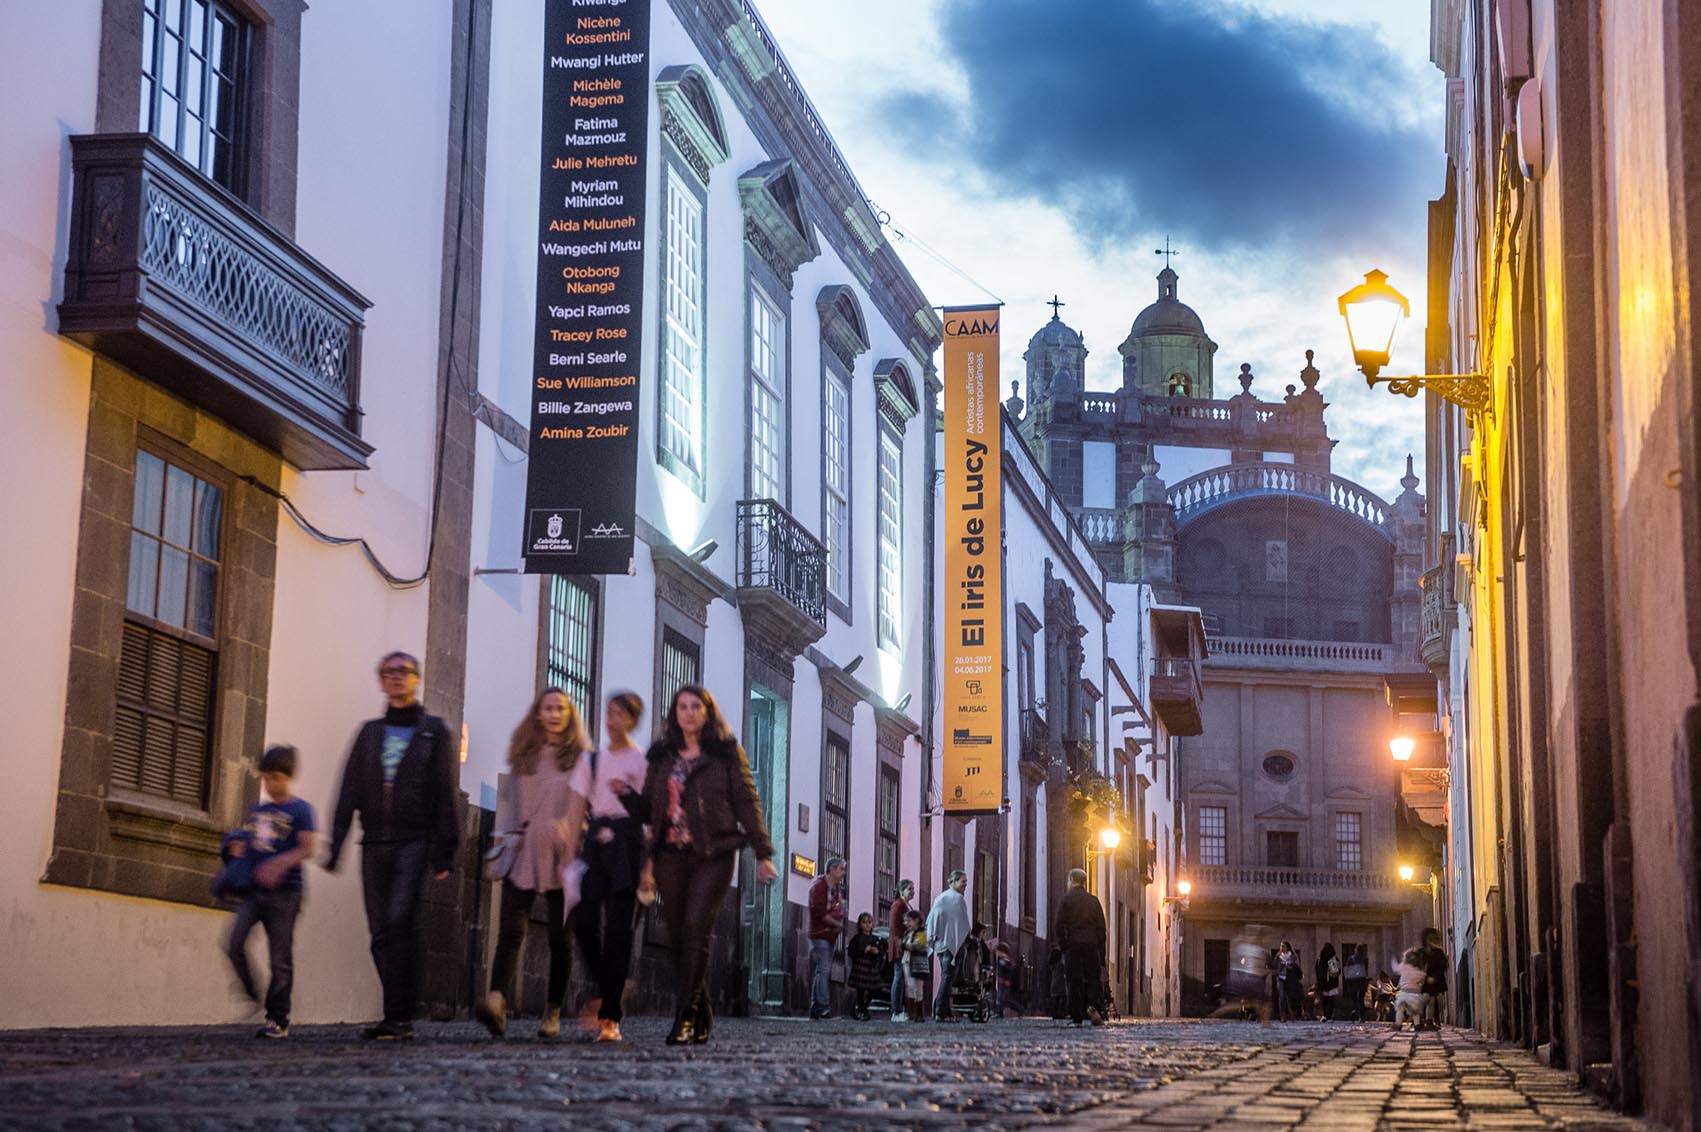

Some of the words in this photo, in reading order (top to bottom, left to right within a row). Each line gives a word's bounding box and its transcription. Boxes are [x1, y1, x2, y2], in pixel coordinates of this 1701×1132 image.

[577, 16, 621, 29] Nicène
[566, 29, 631, 45] Kossentini
[551, 54, 601, 69] Mwangi
[604, 53, 644, 67] Hutter
[573, 78, 622, 92] Michèle
[569, 94, 624, 108] Magema
[575, 117, 618, 131] Fatima
[565, 132, 627, 146] Mazmouz
[551, 157, 583, 170] Julie
[586, 154, 638, 168] Mehretu
[571, 180, 618, 194] Myriam
[564, 194, 624, 208] Mihindou
[548, 219, 580, 232] Aida
[583, 215, 636, 230] Muluneh
[541, 241, 607, 257] Wangechi
[610, 239, 641, 253] Mutu
[562, 266, 620, 279] Otobong
[566, 281, 615, 294] Nkanga
[548, 304, 584, 320] Yapci
[587, 303, 631, 317] Ramos
[550, 329, 593, 343] Tracey
[596, 328, 627, 340] Rose
[945, 318, 999, 337] CAAM
[549, 353, 584, 366] Berni
[587, 350, 627, 364] Searle
[966, 351, 974, 394] africanas
[537, 377, 562, 389] Sue
[565, 375, 636, 389] Williamson
[538, 401, 571, 414] Billie
[573, 400, 633, 415] Zangewa
[966, 397, 974, 434] Artistas
[540, 426, 583, 439] Amina
[586, 423, 629, 438] Zoubir
[962, 438, 988, 512] Lucy
[961, 517, 985, 556] de
[961, 563, 985, 610] iris
[961, 618, 985, 647] El
[958, 705, 988, 713] MUSAC
